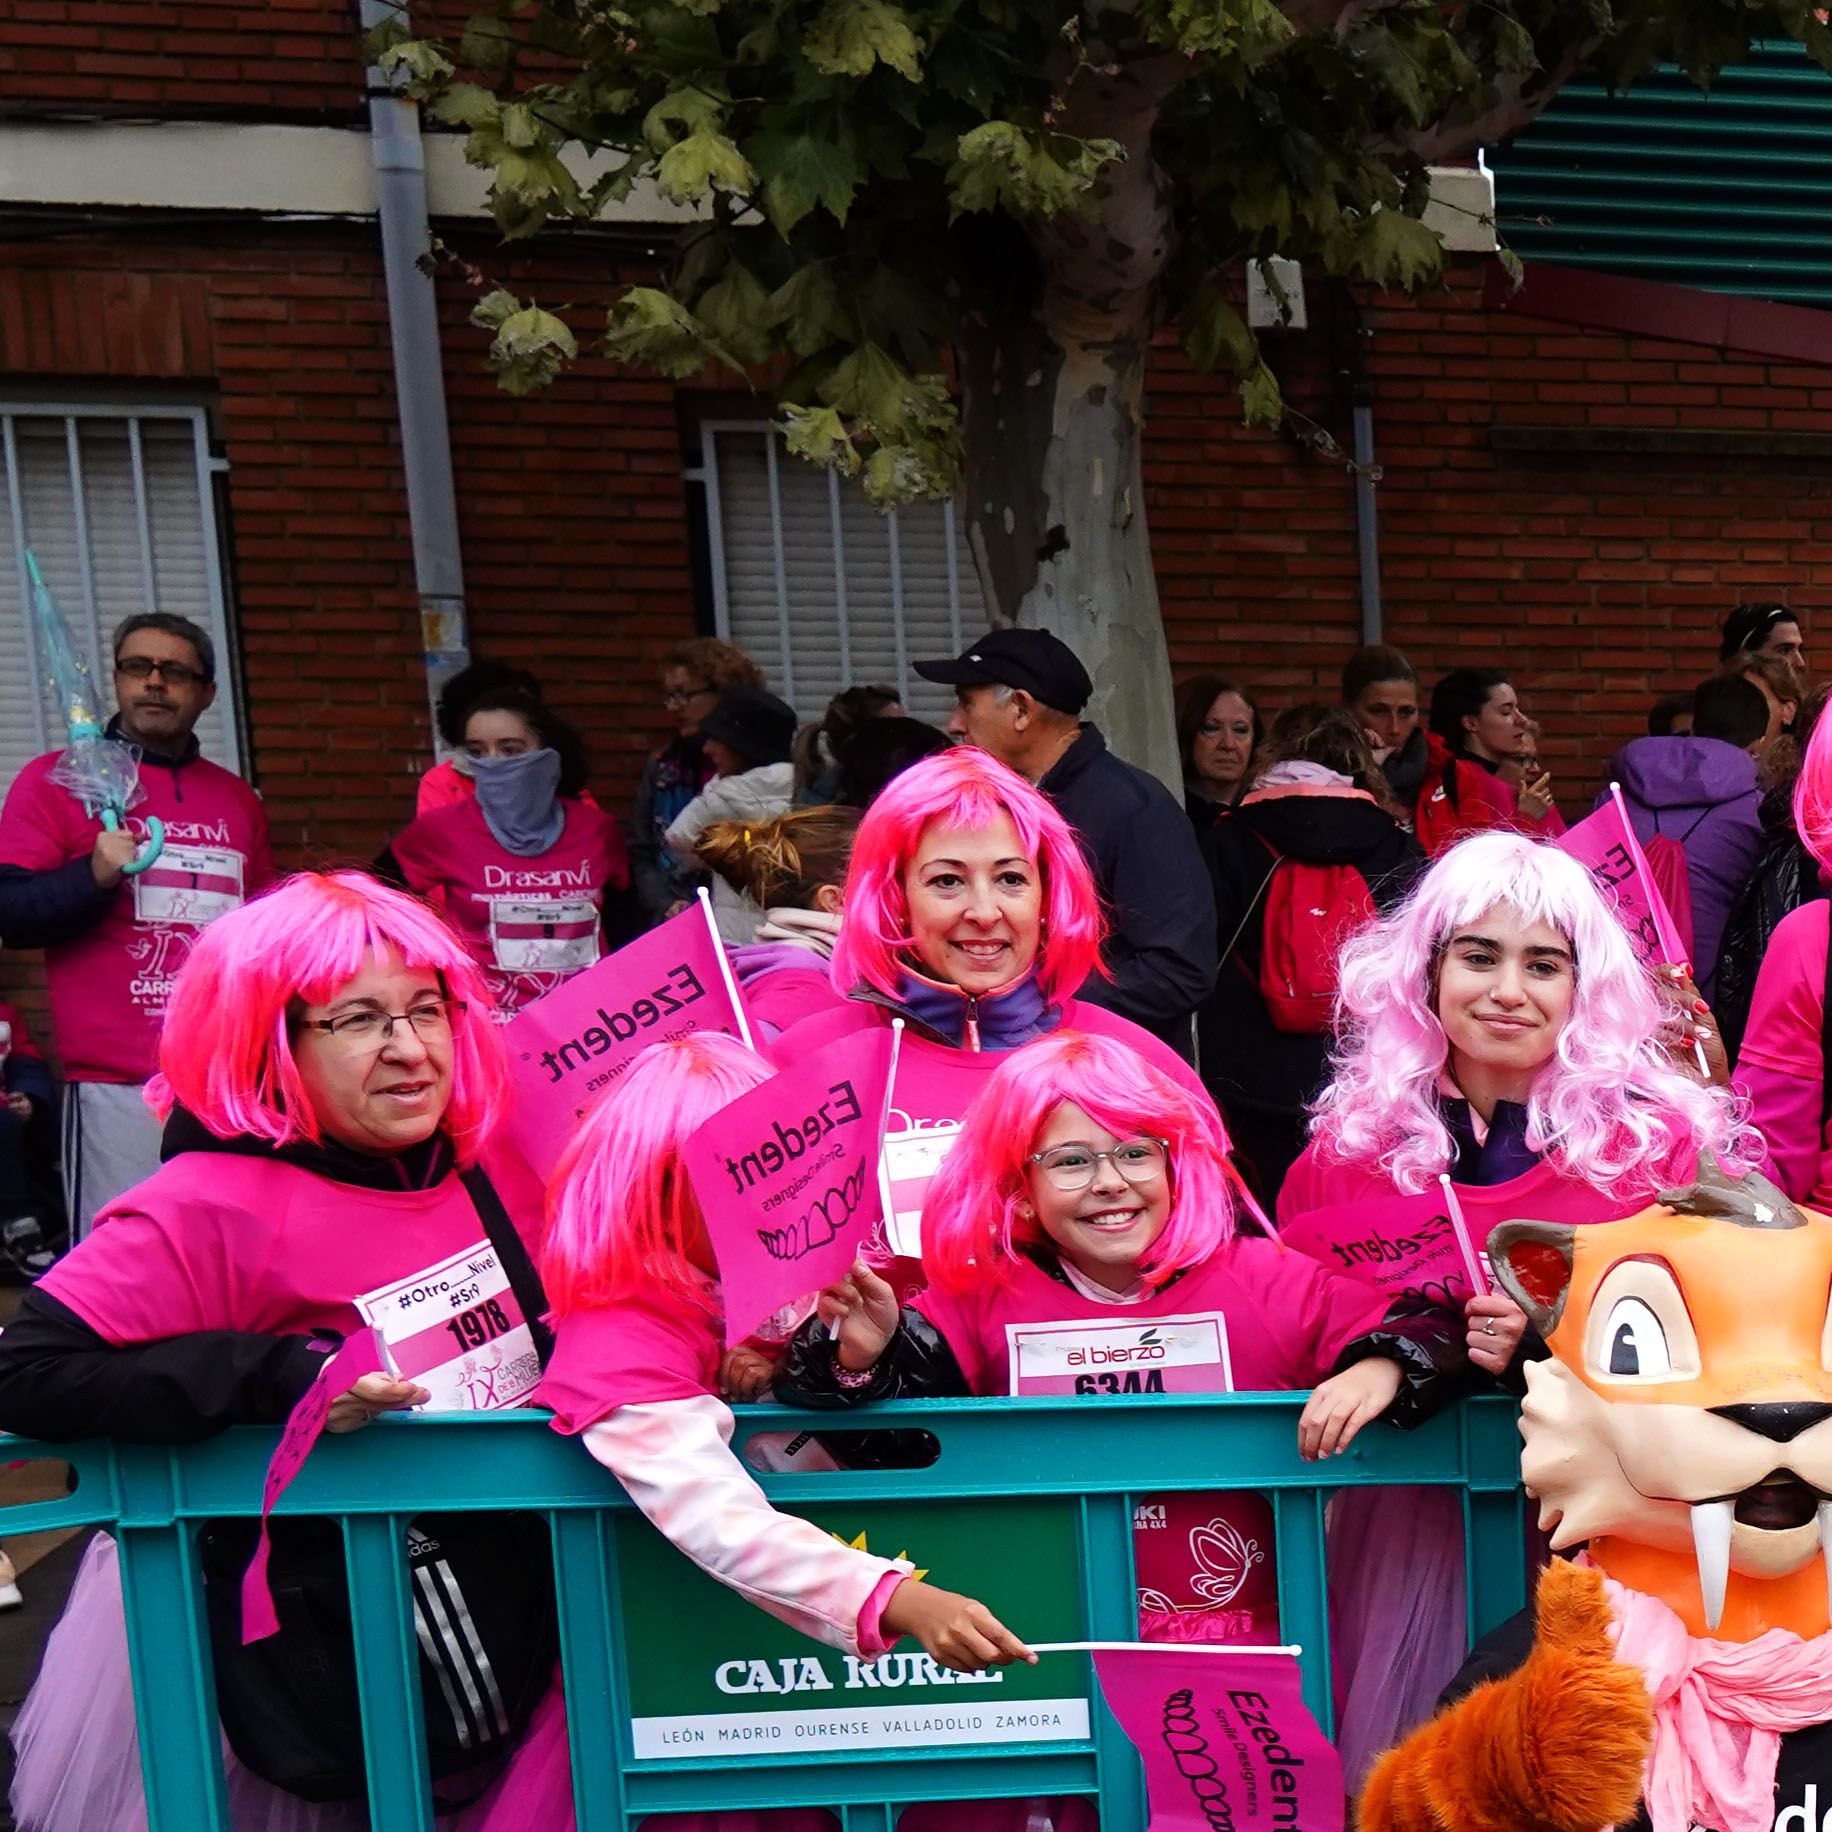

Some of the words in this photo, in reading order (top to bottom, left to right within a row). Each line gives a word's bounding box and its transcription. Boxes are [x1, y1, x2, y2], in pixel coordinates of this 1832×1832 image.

[484, 859, 592, 888] Drasanvi
[446, 1298, 511, 1353] 1978
[1067, 1347, 1087, 1366] el
[1090, 1345, 1166, 1364] bierzo
[715, 1658, 834, 1695] CAJA
[662, 1727, 705, 1745] LEÓN
[718, 1725, 782, 1741] MADRID
[795, 1721, 870, 1737] OURENSE
[883, 1717, 983, 1733] VALLADOLID
[995, 1713, 1062, 1729] ZAMORA
[1233, 1742, 1259, 1817] Designers
